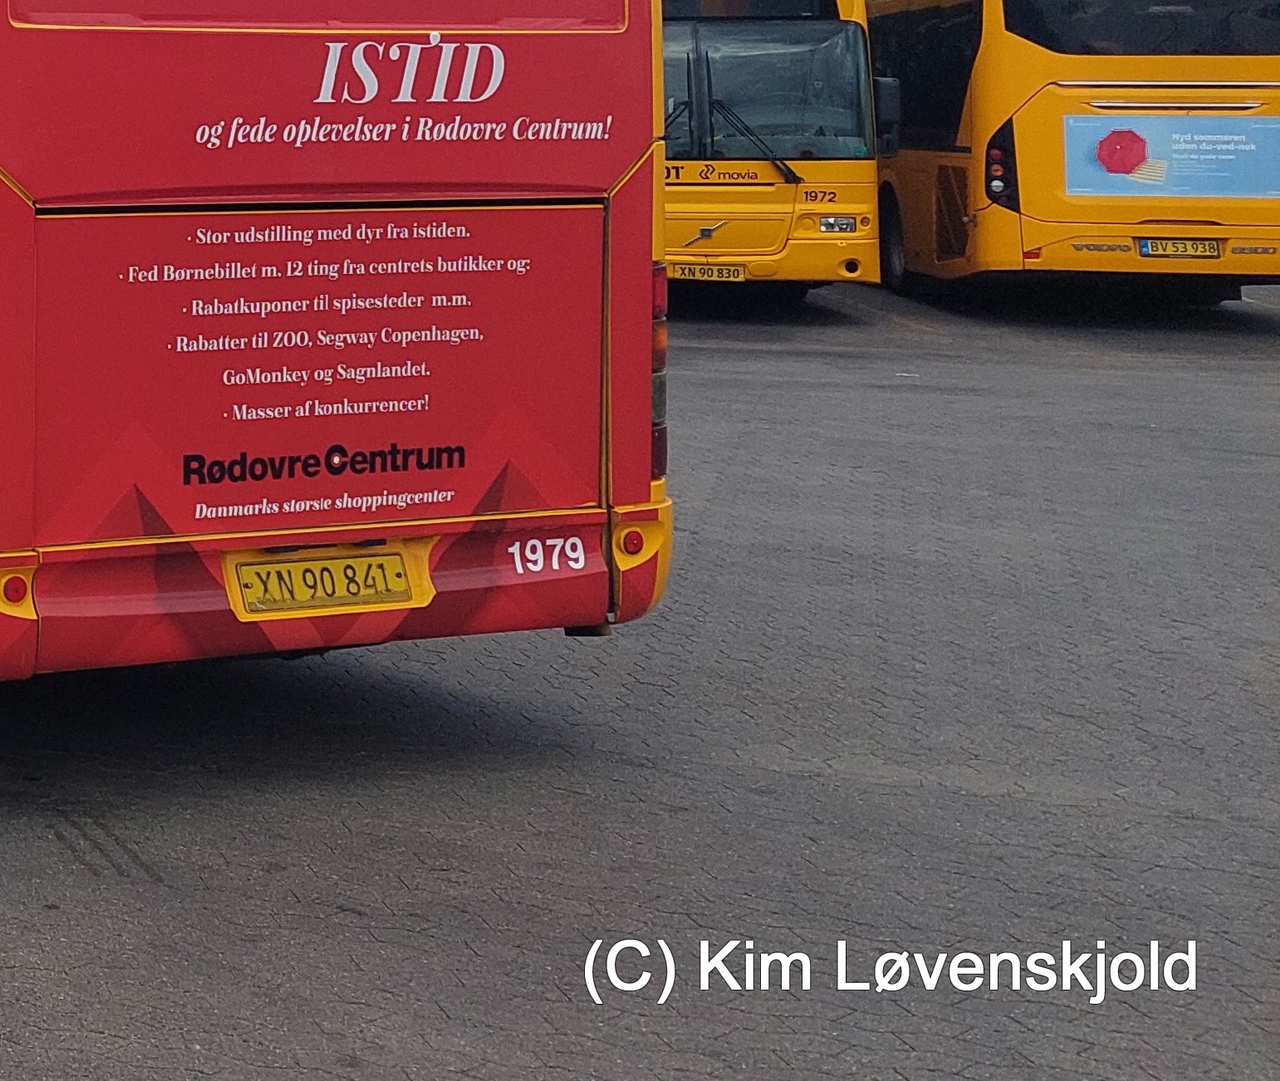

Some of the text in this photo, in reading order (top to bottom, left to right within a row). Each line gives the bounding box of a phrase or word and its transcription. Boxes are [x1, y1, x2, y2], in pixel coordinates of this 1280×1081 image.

[313, 32, 506, 104] ISTID
[195, 115, 613, 149] og fede oplevelser i Rødovre Centrum!
[717, 168, 759, 181] movia
[803, 190, 837, 203] 1972
[195, 222, 471, 247] Stor udstilling med dyr fra istiden.
[1150, 242, 1216, 254] BV 53 938
[128, 265, 159, 283] Fed
[163, 262, 257, 282] Børnebillet
[261, 266, 282, 278] m.
[286, 260, 303, 277] 12
[307, 259, 339, 280] ting
[343, 259, 365, 275] fra
[369, 258, 434, 274] centrets
[437, 255, 504, 272] butikker
[679, 266, 740, 279] XN 90 830
[191, 297, 310, 318] Rabatkuponer
[313, 295, 329, 311] til
[332, 292, 425, 315] spisesteder
[176, 325, 484, 352] Rabatter til ZOO, Segway Copenhagen,
[222, 361, 431, 387] GoMonkey og Sagnlandet.
[232, 394, 430, 421] Masser af konkurrencer!
[182, 443, 466, 486] Rødovre Centrum
[194, 488, 455, 520] Danmarks største shoppingcenter
[507, 536, 586, 575] 1979
[302, 566, 337, 599] 90
[343, 562, 394, 597] 841
